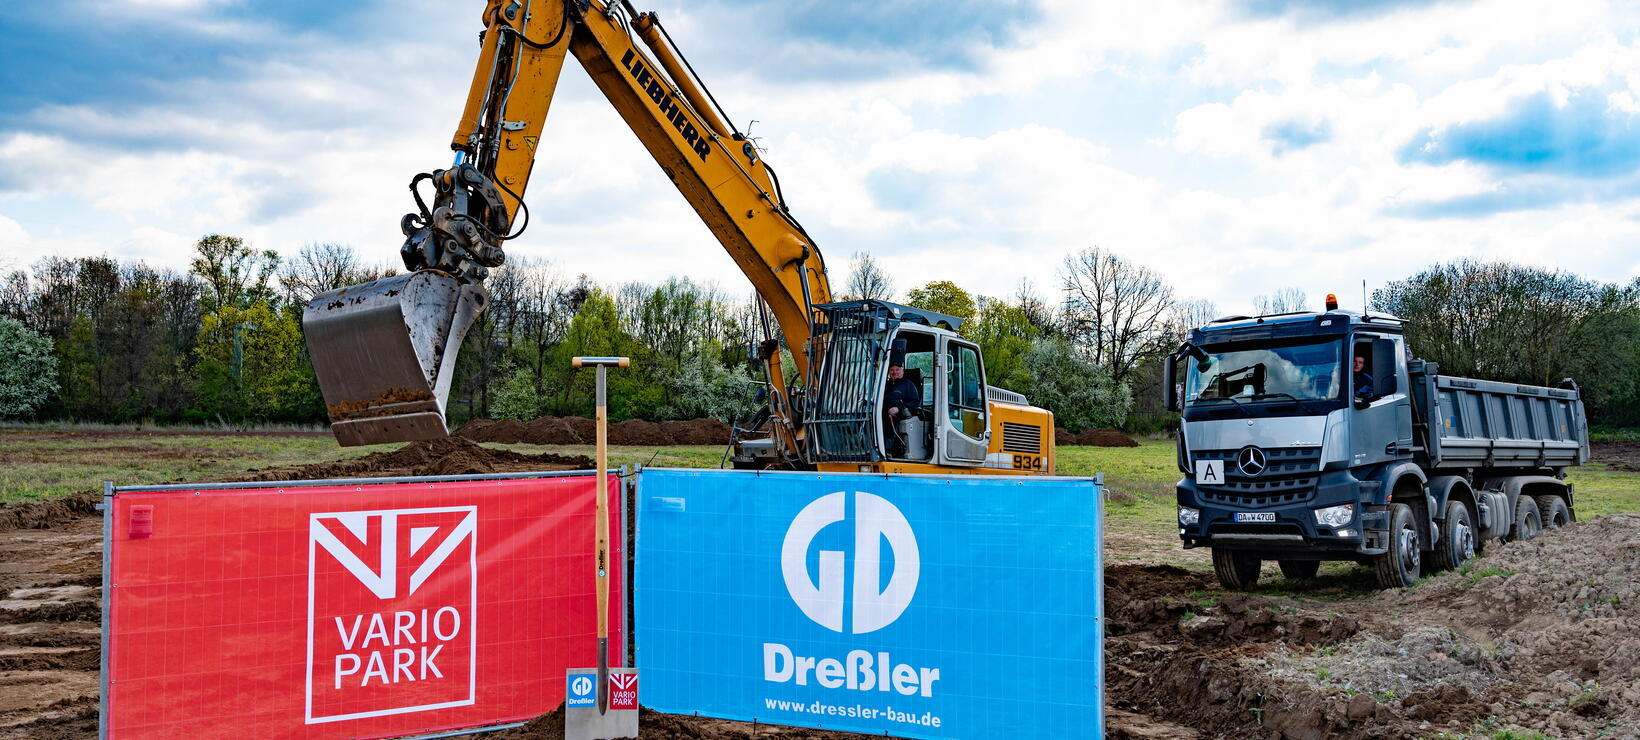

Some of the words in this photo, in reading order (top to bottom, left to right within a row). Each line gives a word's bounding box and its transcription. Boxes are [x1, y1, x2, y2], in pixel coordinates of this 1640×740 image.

[621, 48, 711, 163] LIEBHERR
[1013, 455, 1041, 470] 934
[1203, 463, 1216, 480] A
[1256, 513, 1275, 521] 4700
[781, 491, 920, 634] GD
[334, 606, 461, 650] VARIO
[335, 644, 444, 689] PARK
[763, 642, 940, 698] Dreßler
[572, 676, 592, 696] GD
[613, 690, 636, 699] VARIO
[568, 697, 595, 705] Dreßler
[613, 697, 633, 706] PARK
[765, 698, 942, 728] www.dressler-bau.de
